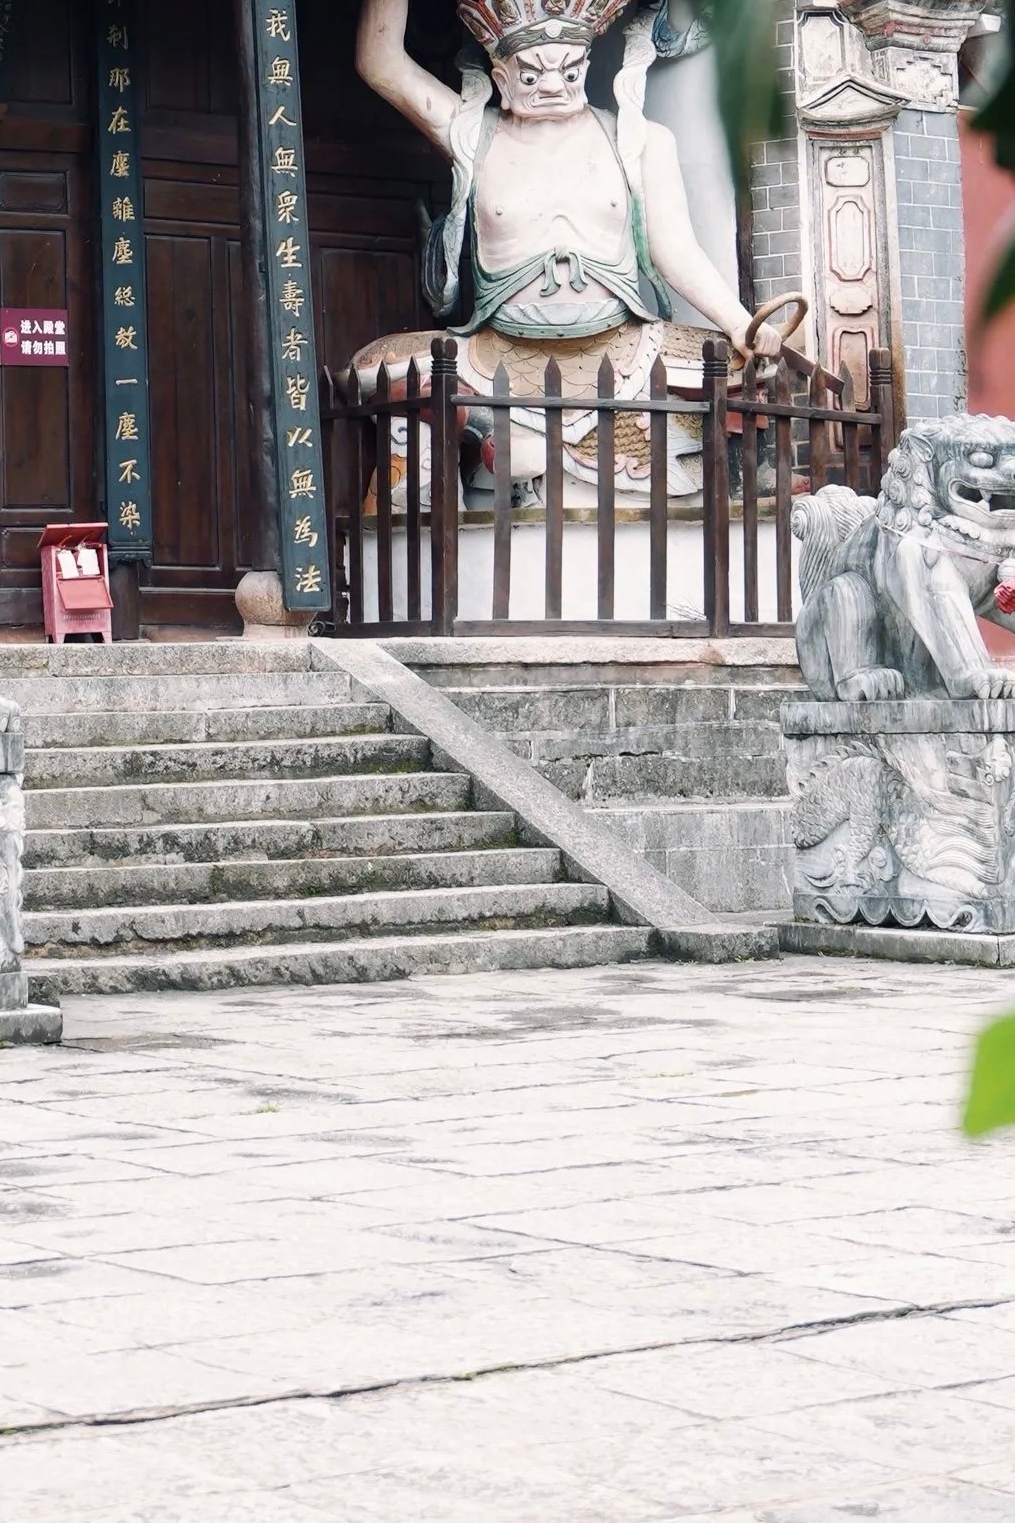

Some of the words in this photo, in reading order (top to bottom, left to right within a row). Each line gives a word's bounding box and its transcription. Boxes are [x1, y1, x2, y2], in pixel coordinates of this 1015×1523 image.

[20, 319, 66, 335] 进入殿堂
[20, 340, 66, 355] 请勿拍照
